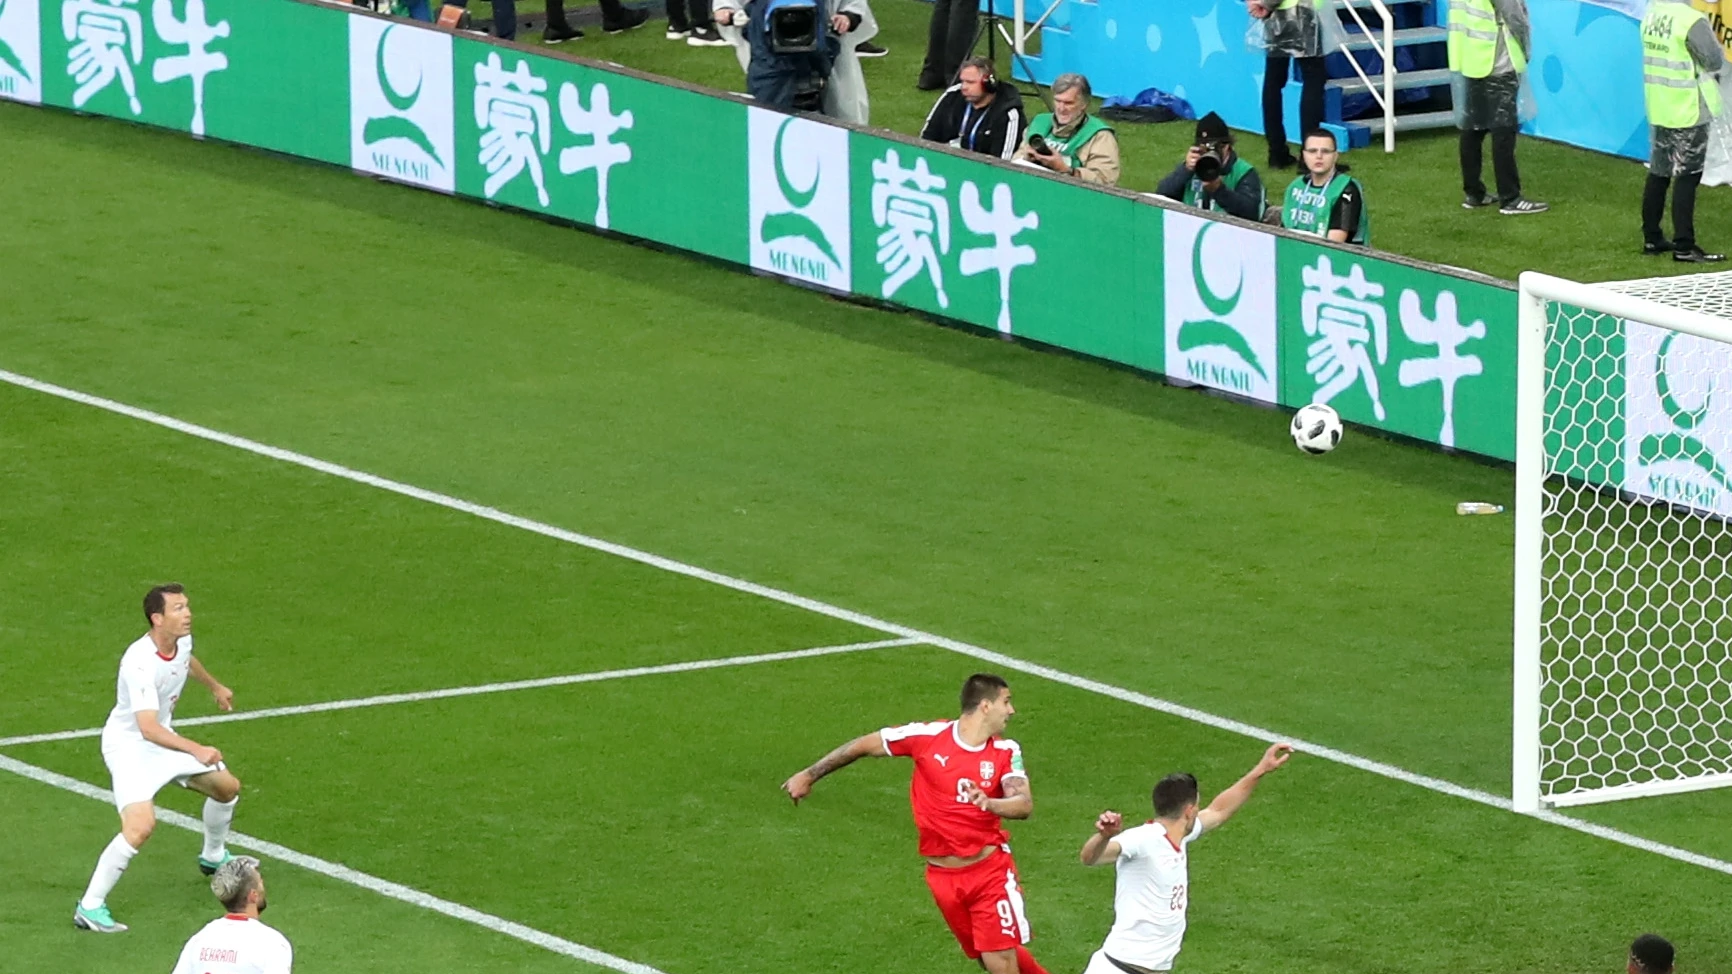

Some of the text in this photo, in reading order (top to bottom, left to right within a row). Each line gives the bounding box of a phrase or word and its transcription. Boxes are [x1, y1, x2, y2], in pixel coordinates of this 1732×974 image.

[62, 0, 230, 136] 蒙牛
[474, 51, 634, 229] 蒙牛
[769, 248, 829, 281] MENGNIU
[872, 148, 1039, 335] 蒙牛
[1186, 357, 1255, 392] MENGNIU
[1301, 253, 1487, 447] 蒙牛
[996, 900, 1014, 928] 9
